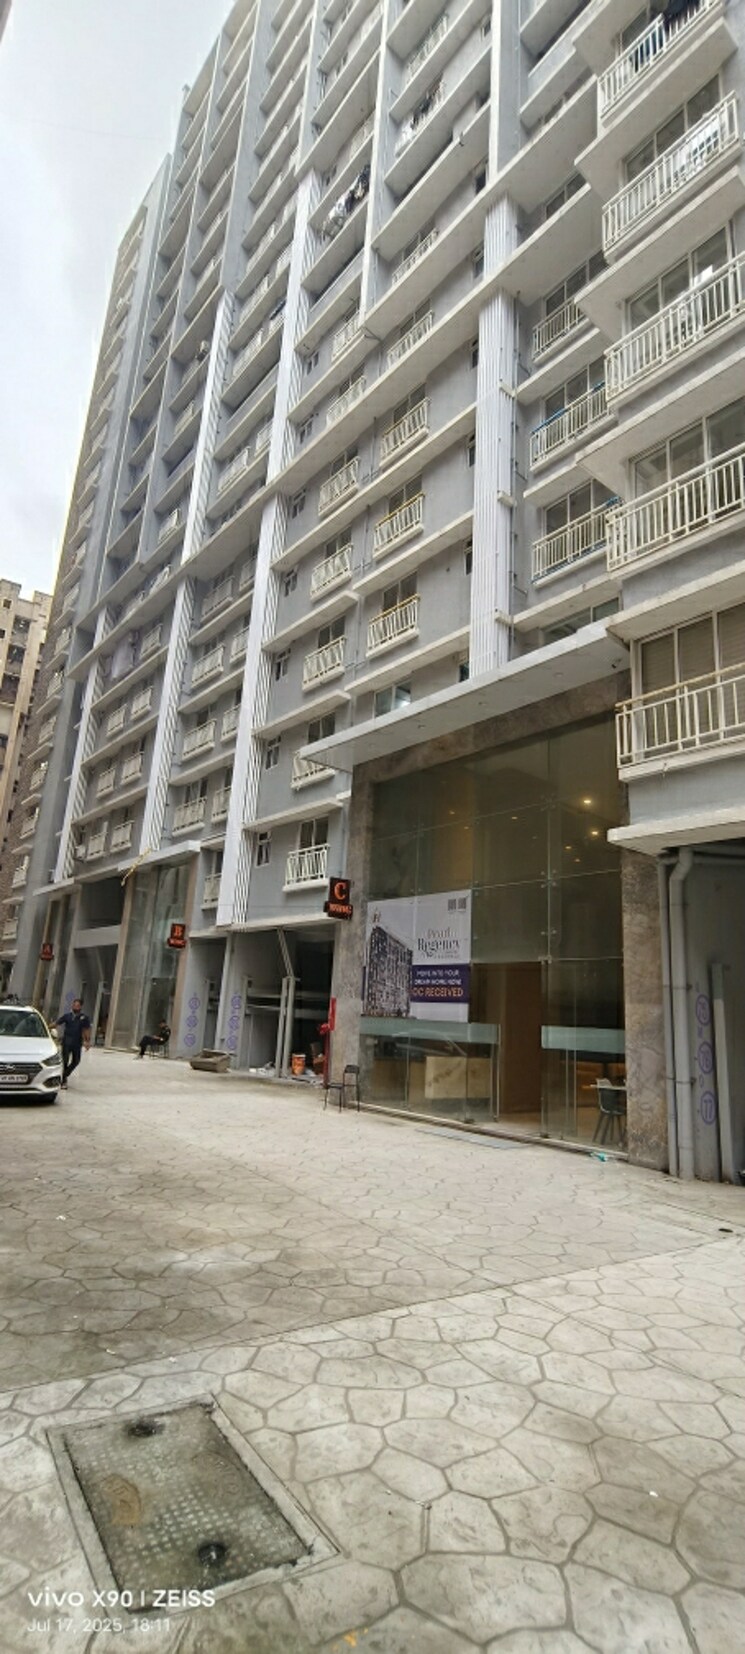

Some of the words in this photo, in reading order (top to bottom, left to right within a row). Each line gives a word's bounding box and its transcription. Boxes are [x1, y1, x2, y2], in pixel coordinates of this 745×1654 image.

[334, 882, 347, 900] C
[174, 925, 184, 937] B
[418, 938, 460, 956] Regency
[425, 987, 464, 997] RECEIVED
